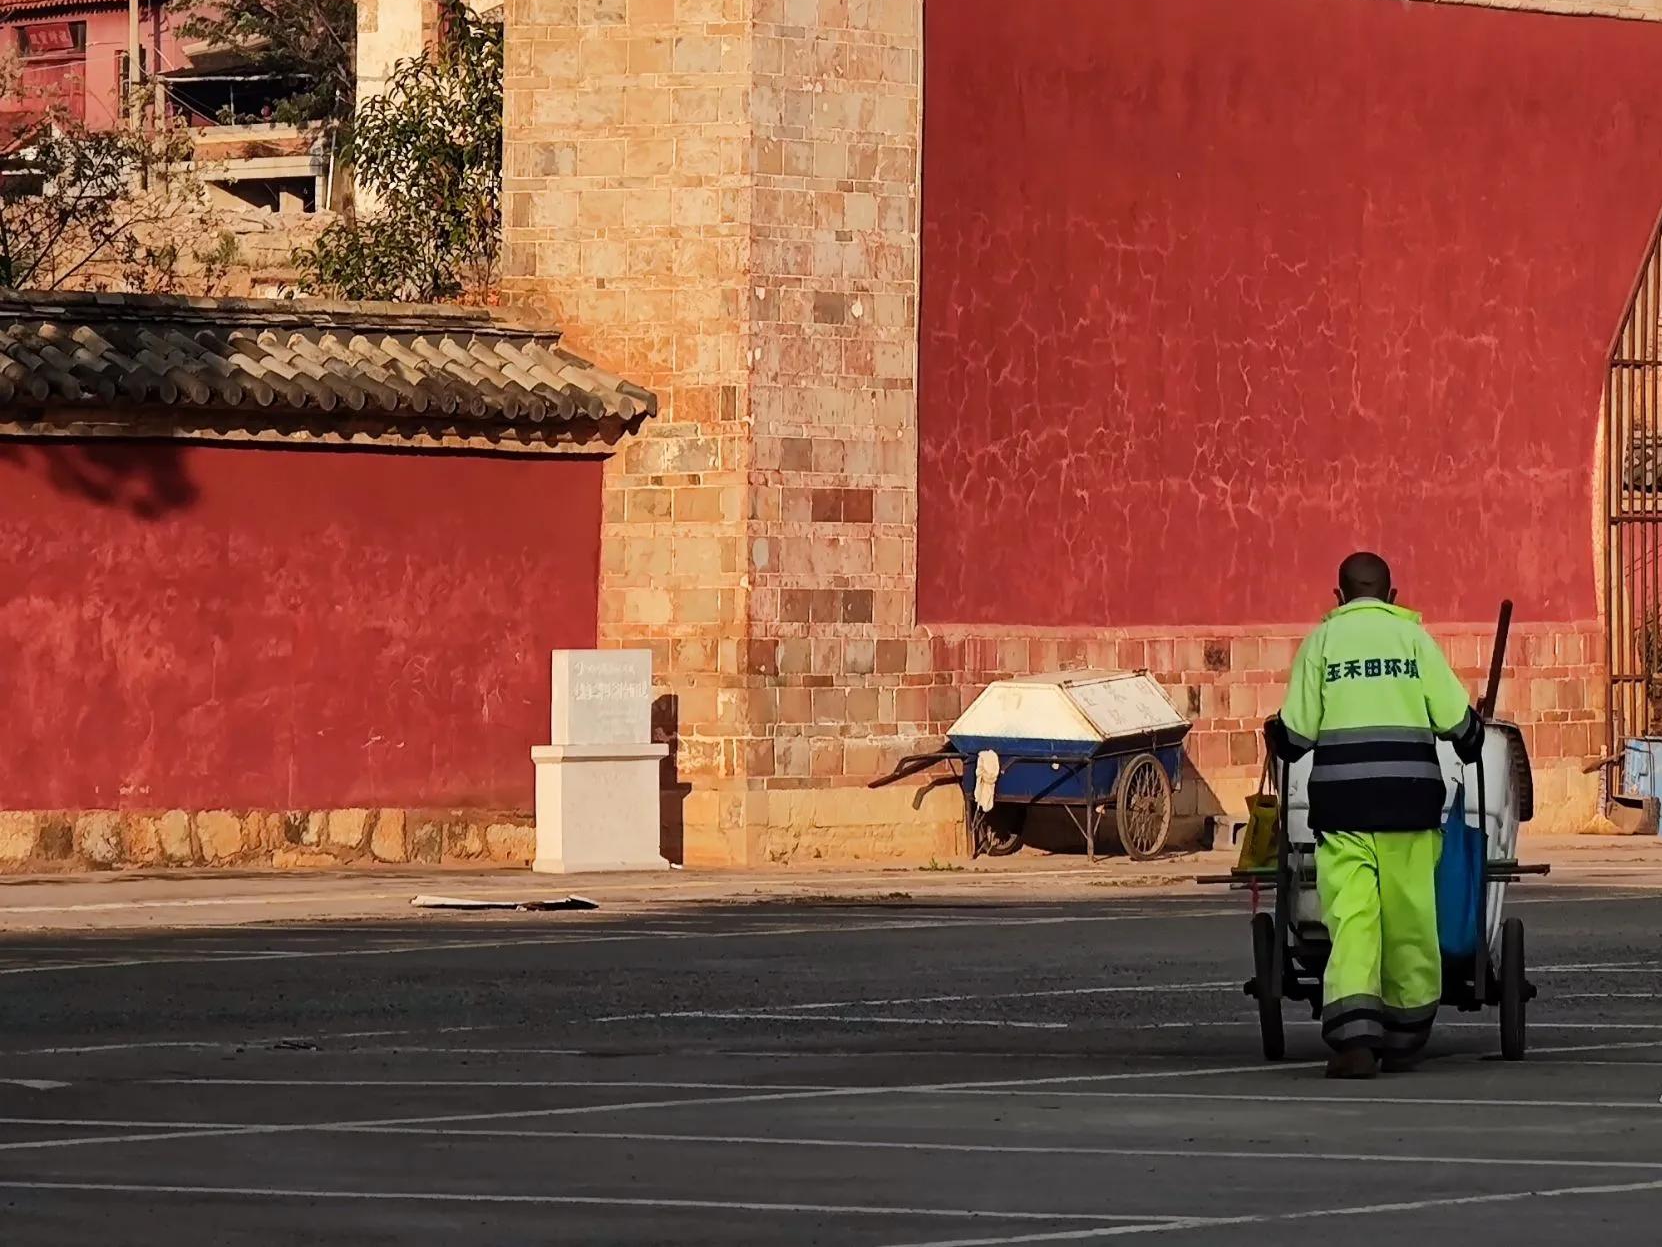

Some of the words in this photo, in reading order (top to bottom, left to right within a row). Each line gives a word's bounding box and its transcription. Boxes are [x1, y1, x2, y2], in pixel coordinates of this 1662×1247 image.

[1325, 658, 1420, 683] 玉禾田环境
